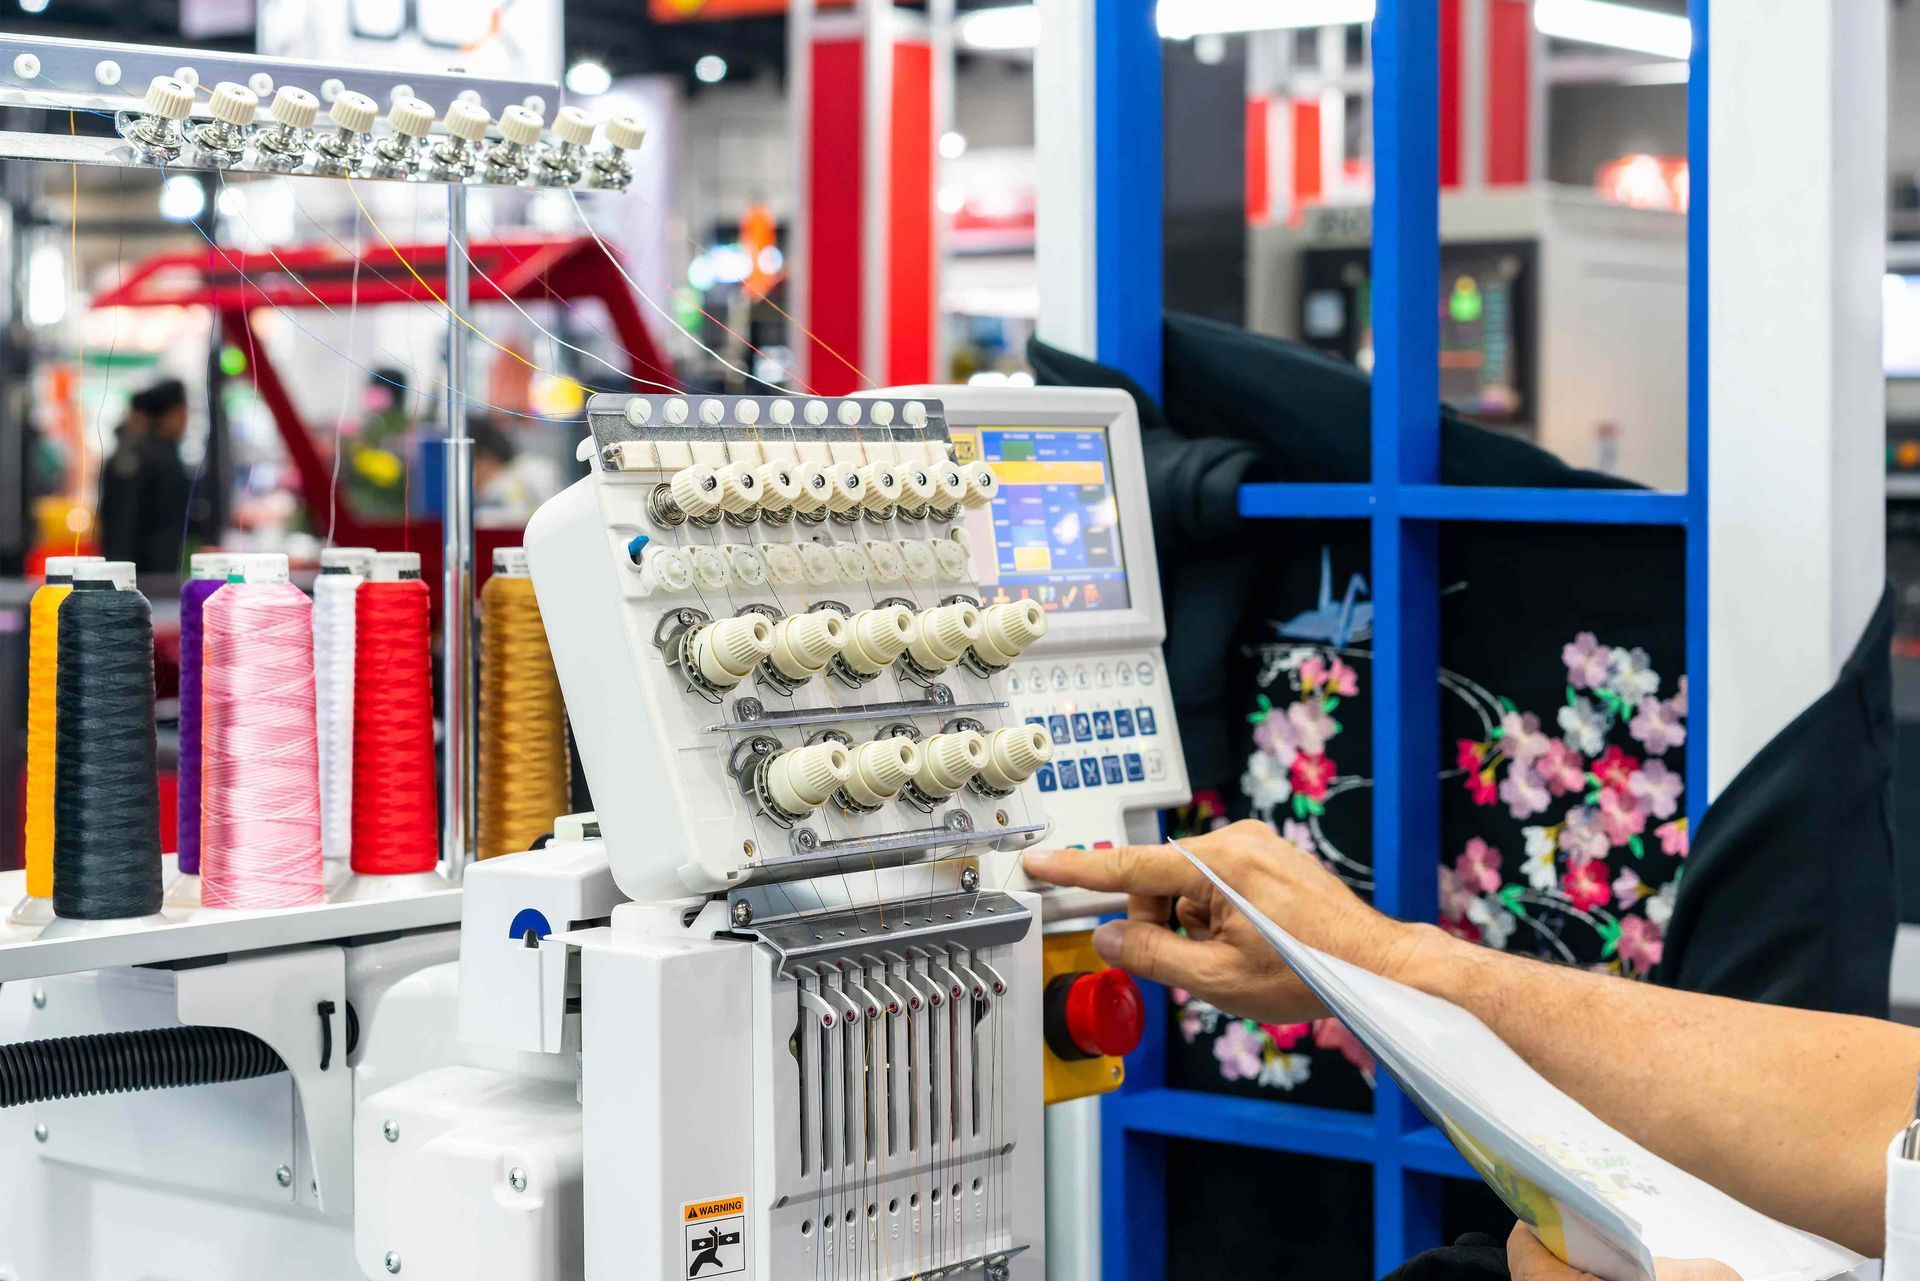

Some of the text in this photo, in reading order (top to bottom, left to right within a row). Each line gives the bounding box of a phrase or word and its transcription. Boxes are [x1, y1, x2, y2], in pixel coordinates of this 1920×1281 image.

[699, 1201, 742, 1216] WARNING
[827, 1239, 833, 1255] 2
[849, 1234, 855, 1250] 3
[891, 1223, 899, 1239] 5
[913, 1217, 919, 1233] 6
[954, 1207, 961, 1223] 8
